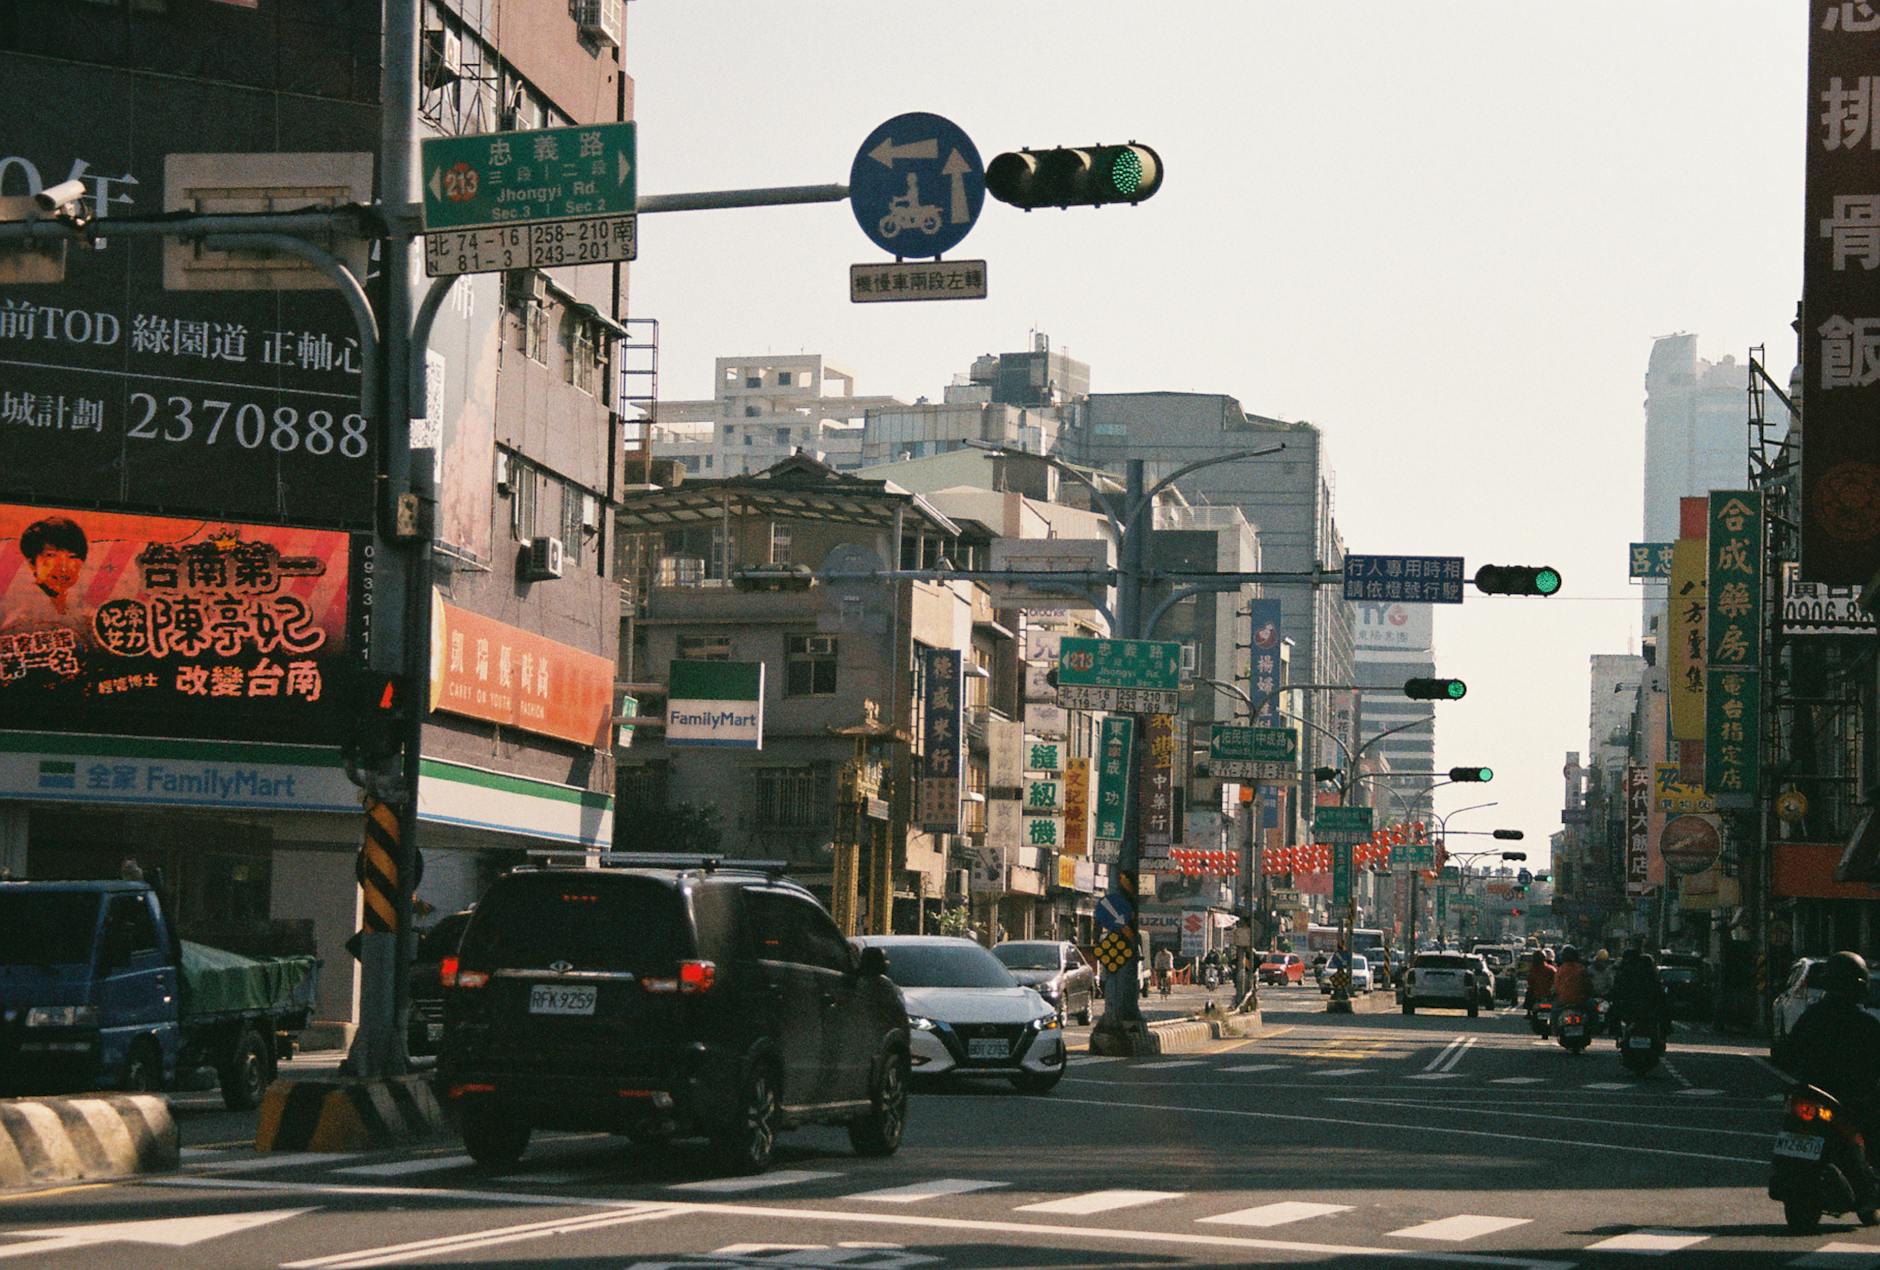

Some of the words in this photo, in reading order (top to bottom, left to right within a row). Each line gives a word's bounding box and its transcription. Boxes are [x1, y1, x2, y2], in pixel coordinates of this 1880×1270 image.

[488, 132, 604, 166] 忠義路
[446, 171, 478, 197] 213
[497, 184, 562, 203] Jhongyi
[429, 235, 450, 256] 北
[534, 221, 609, 245] 258-210
[613, 220, 634, 243] 南
[429, 261, 440, 272] N
[534, 242, 609, 264] 243-201
[132, 314, 249, 362] 綠園道
[127, 393, 369, 458] 2370888
[140, 543, 319, 590] 台南第一
[1348, 558, 1460, 579] 行人專用時相
[1717, 498, 1755, 663] 合成藥房
[362, 545, 375, 670] 0933111
[152, 598, 326, 657] 陳亭妃
[176, 658, 322, 701] 改變台南
[671, 711, 757, 729] FamilyMart
[87, 763, 138, 790] 全家
[146, 766, 296, 798] FamilyMart
[1029, 743, 1058, 845] 縫紉機
